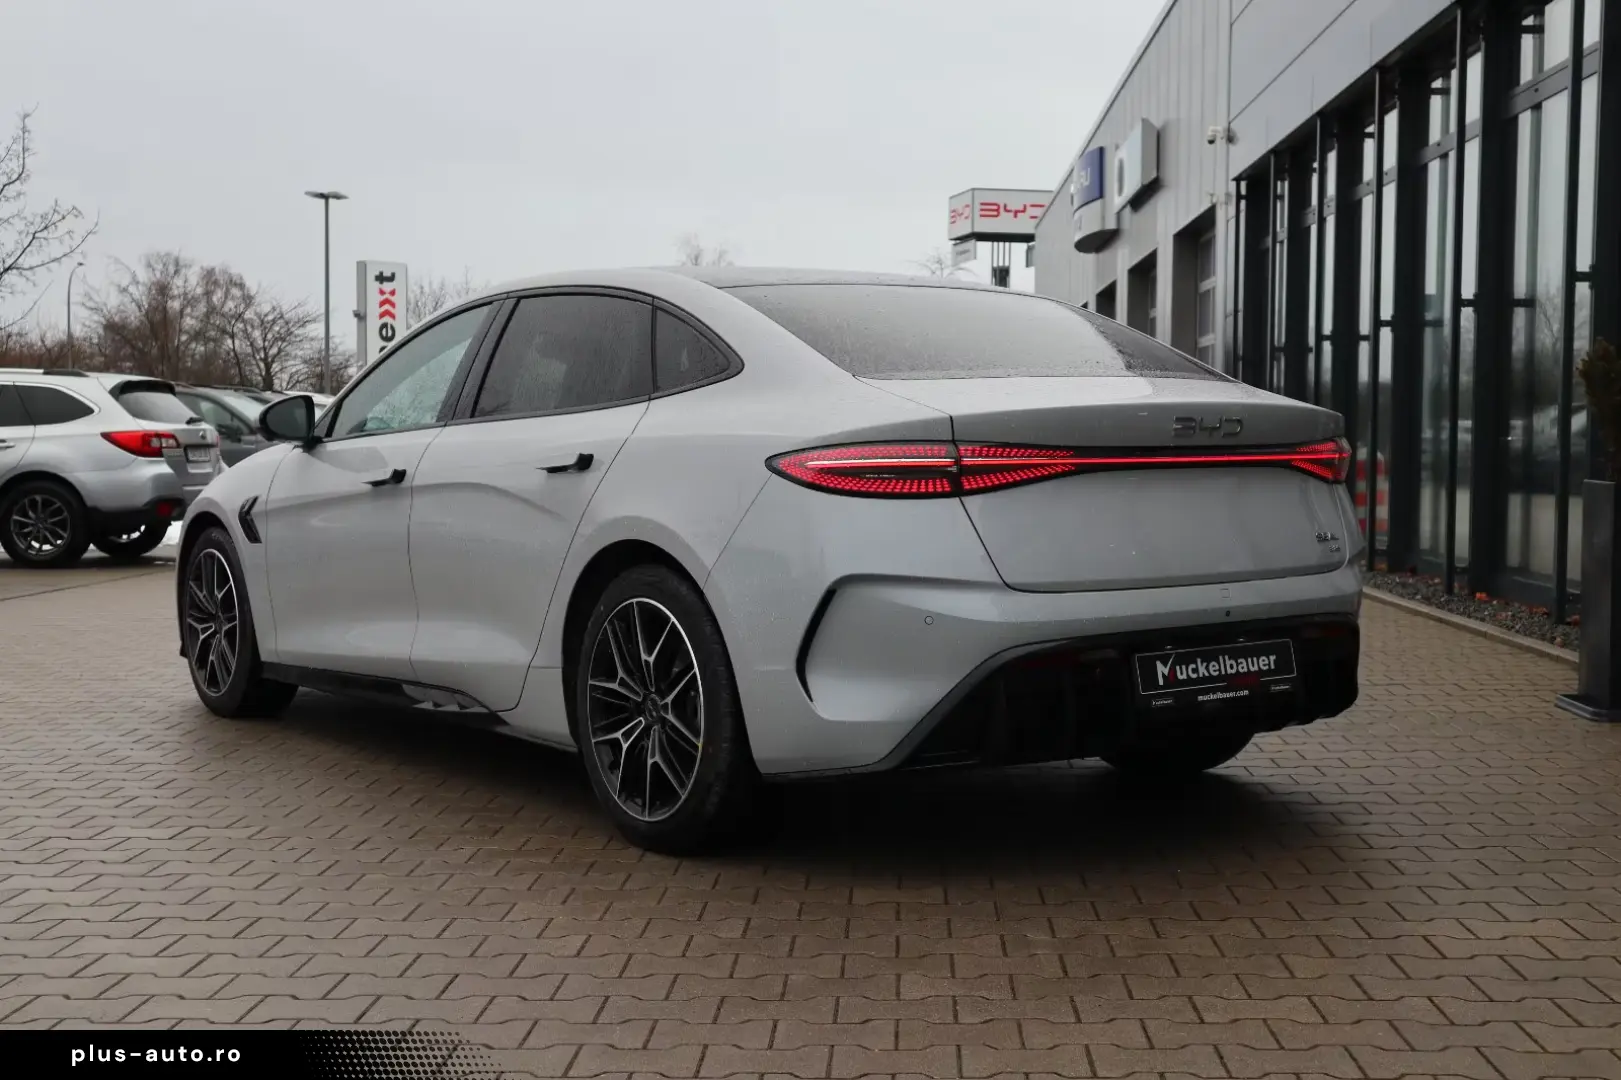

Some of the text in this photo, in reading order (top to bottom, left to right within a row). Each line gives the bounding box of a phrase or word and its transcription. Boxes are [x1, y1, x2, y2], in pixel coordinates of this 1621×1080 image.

[1172, 415, 1243, 438] BYD
[1155, 652, 1277, 686] Muckelbauer
[1197, 689, 1250, 702] muckelbauer.com
